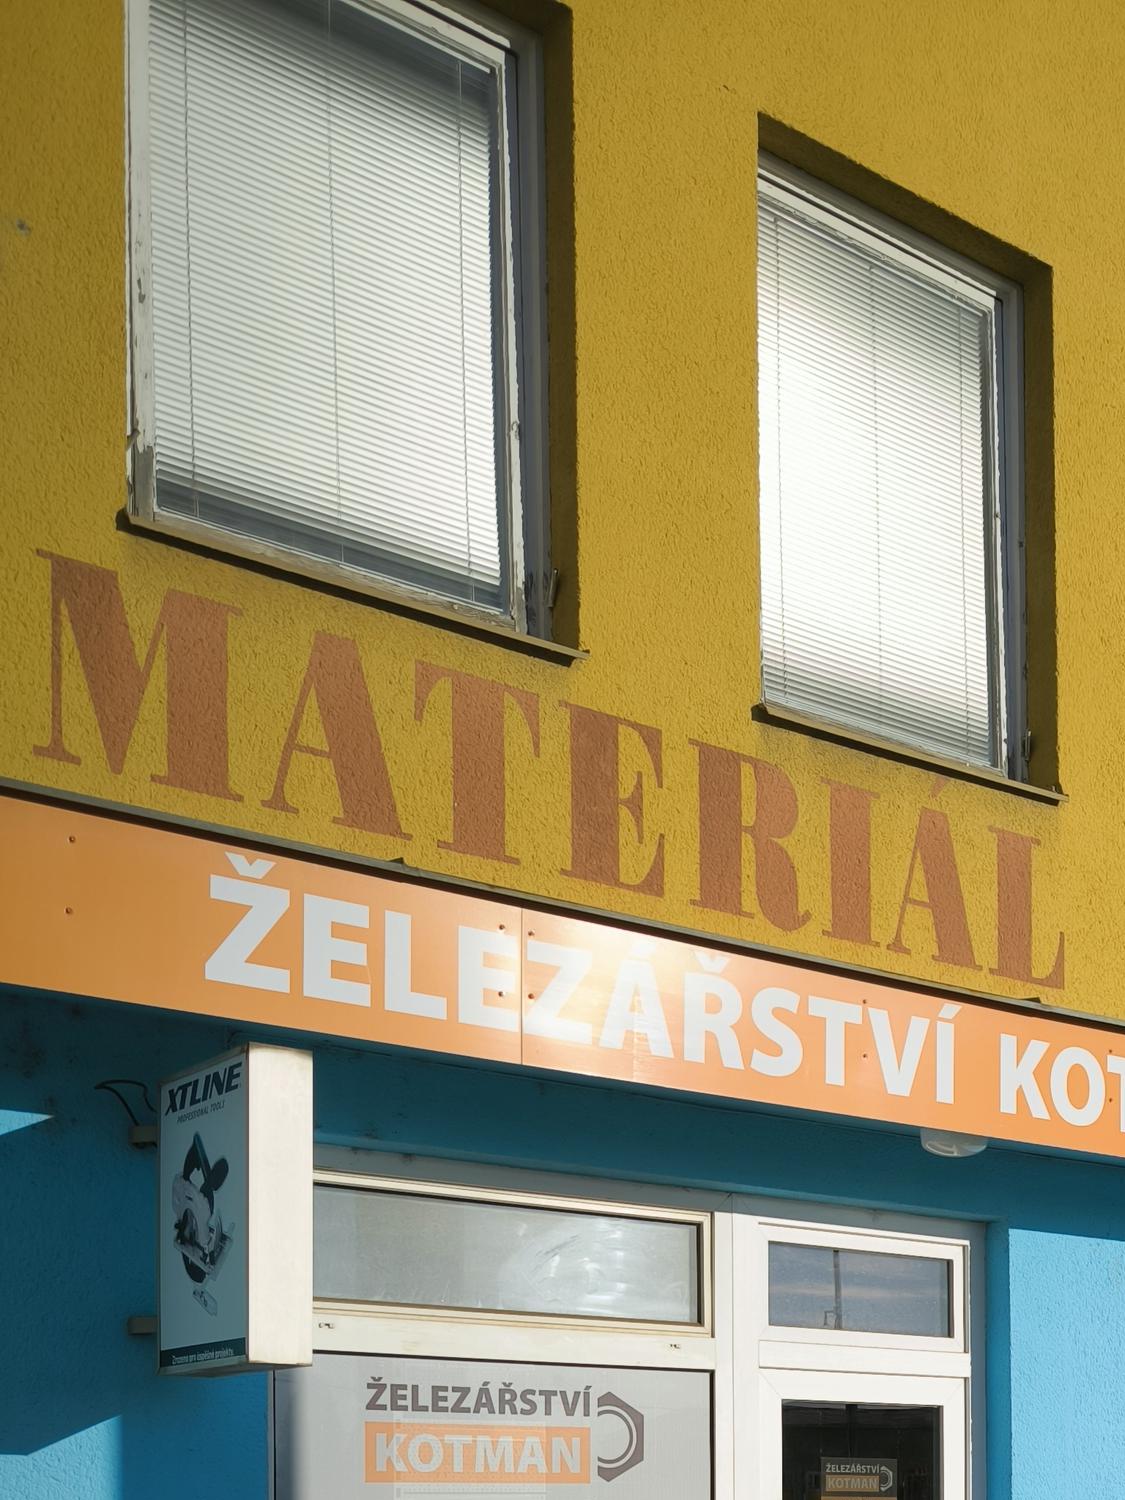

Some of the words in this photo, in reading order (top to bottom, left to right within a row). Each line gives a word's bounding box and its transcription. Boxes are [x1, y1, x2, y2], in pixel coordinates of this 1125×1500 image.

[33, 548, 1066, 990] MATERIÁL
[204, 851, 958, 1104] ŽELEZÁŘSTVÍ
[165, 1061, 242, 1116] XTLINE
[366, 1376, 592, 1417] ŽELEZÁŘSTVÍ
[374, 1431, 582, 1474] KOTMAN
[825, 1462, 880, 1474] ŽELEZÁŘSTVÍ
[828, 1477, 879, 1489] KOTMAN
